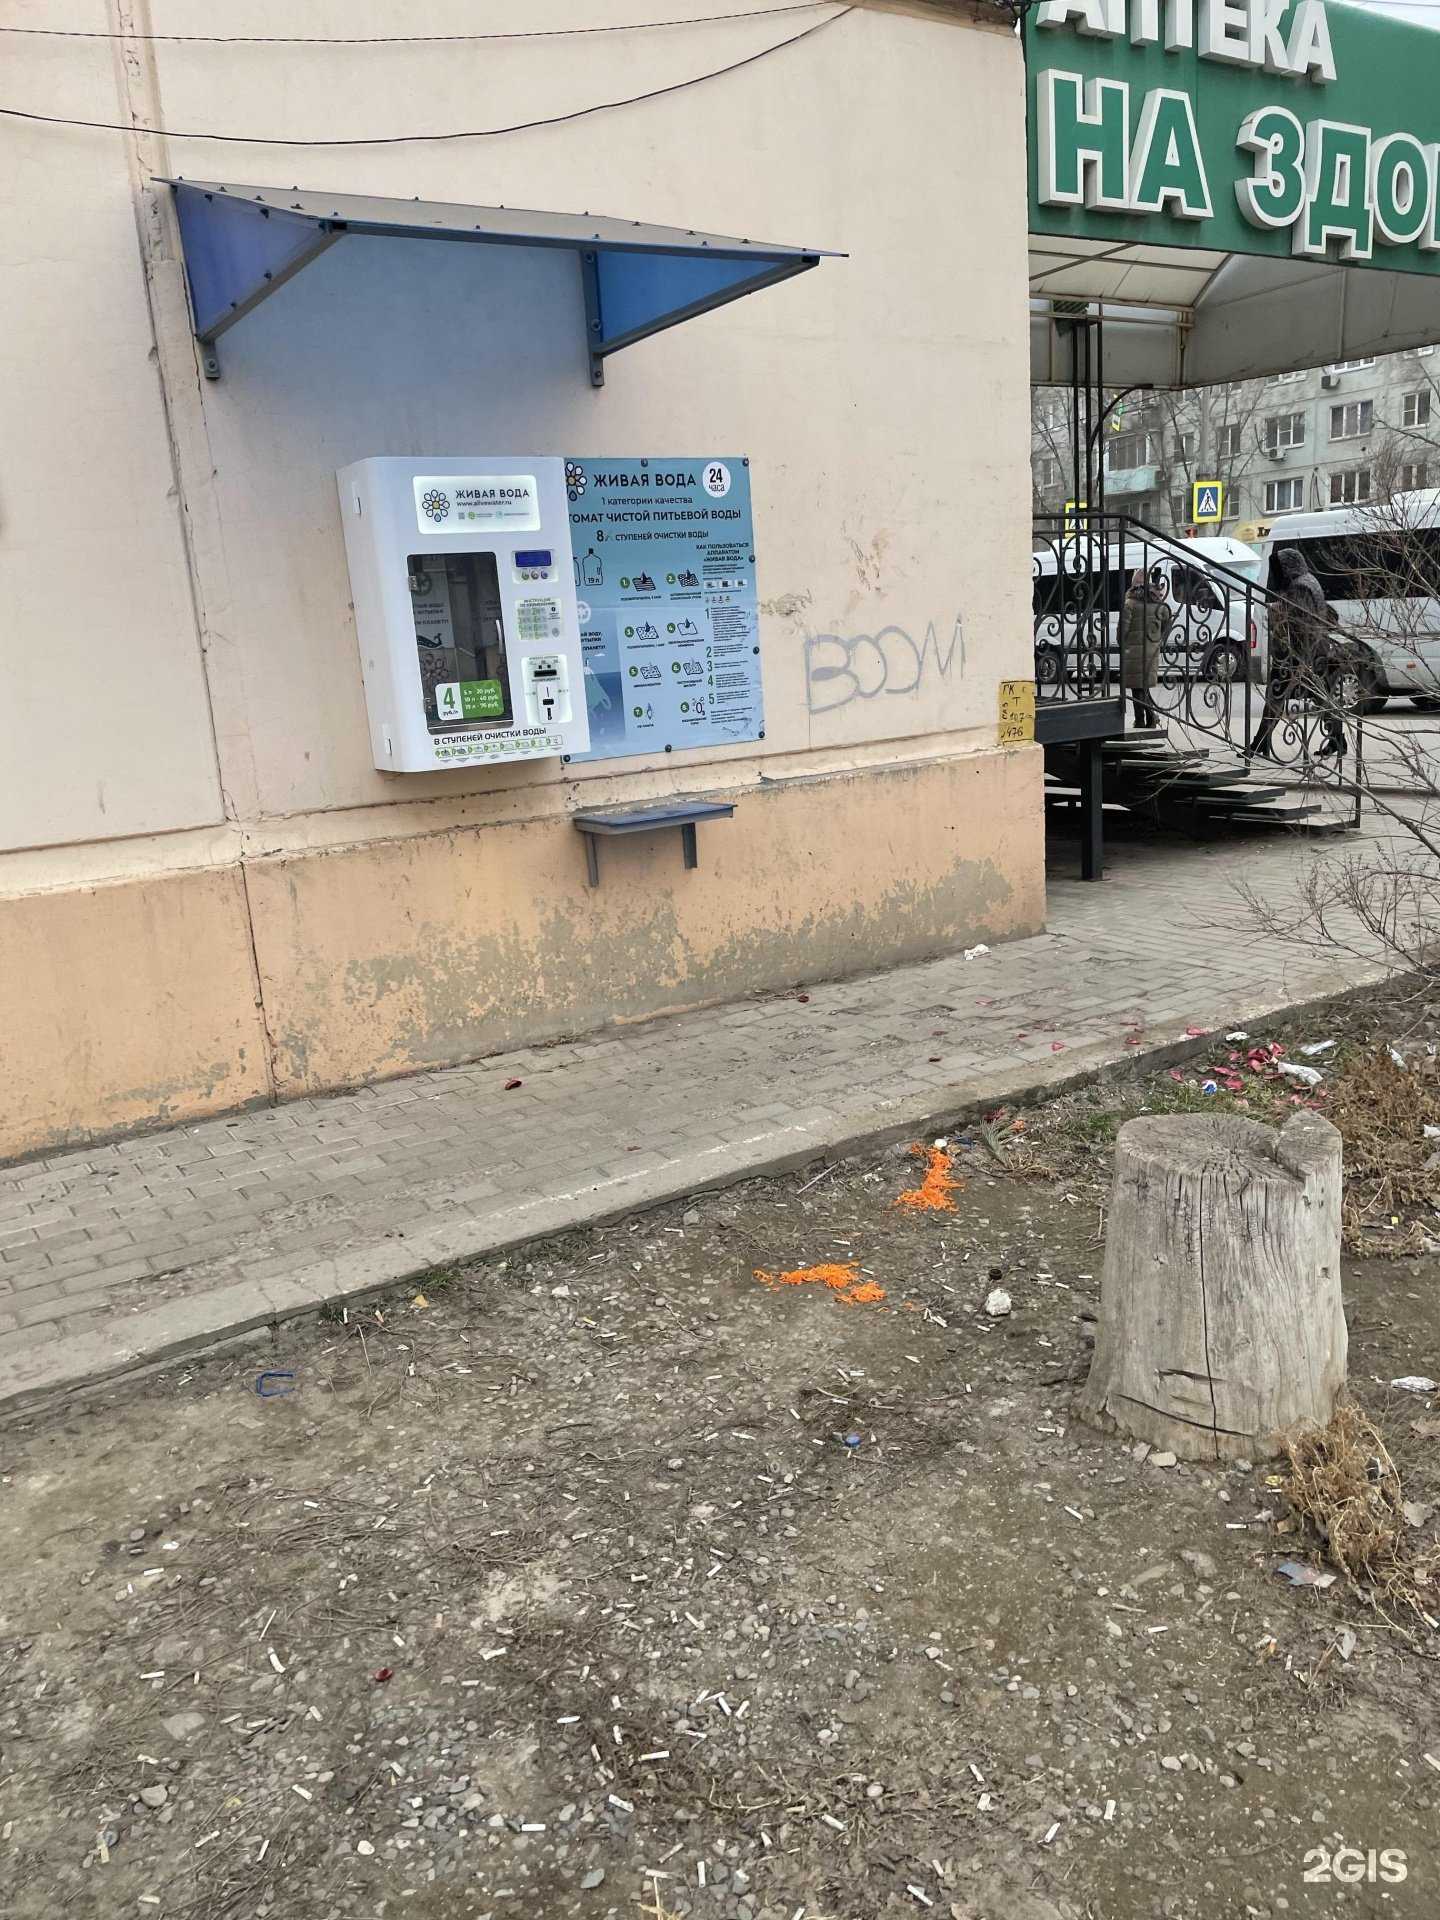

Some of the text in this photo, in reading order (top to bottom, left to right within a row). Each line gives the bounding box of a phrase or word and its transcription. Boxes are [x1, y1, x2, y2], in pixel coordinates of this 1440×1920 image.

[1037, 69, 1440, 260] НА ЗДО
[593, 473, 696, 488] ЖИВАЯ ВОДА
[709, 468, 723, 484] 24
[708, 483, 725, 492] часа
[455, 488, 530, 499] ЖИВАЯ ВОДА
[607, 497, 653, 506] категории
[655, 497, 693, 505] качества
[606, 510, 650, 522] ЧИСТОЙ
[653, 508, 709, 521] ПИТЬЕВОЙ
[712, 509, 741, 520] ВОДЫ
[616, 532, 652, 541] СТУПЕНЕЙ
[653, 532, 686, 540] ОЧИСТКИ
[688, 531, 708, 539] ВОДЫ
[706, 647, 712, 658] 2
[707, 661, 713, 672] 3
[708, 675, 714, 686] 4
[443, 687, 455, 709] 4
[709, 694, 715, 705] 5
[442, 733, 483, 745] СТУПЕНЕЙ
[484, 730, 521, 741] ОЧИСТКИ
[522, 728, 547, 737] ВОДЫ
